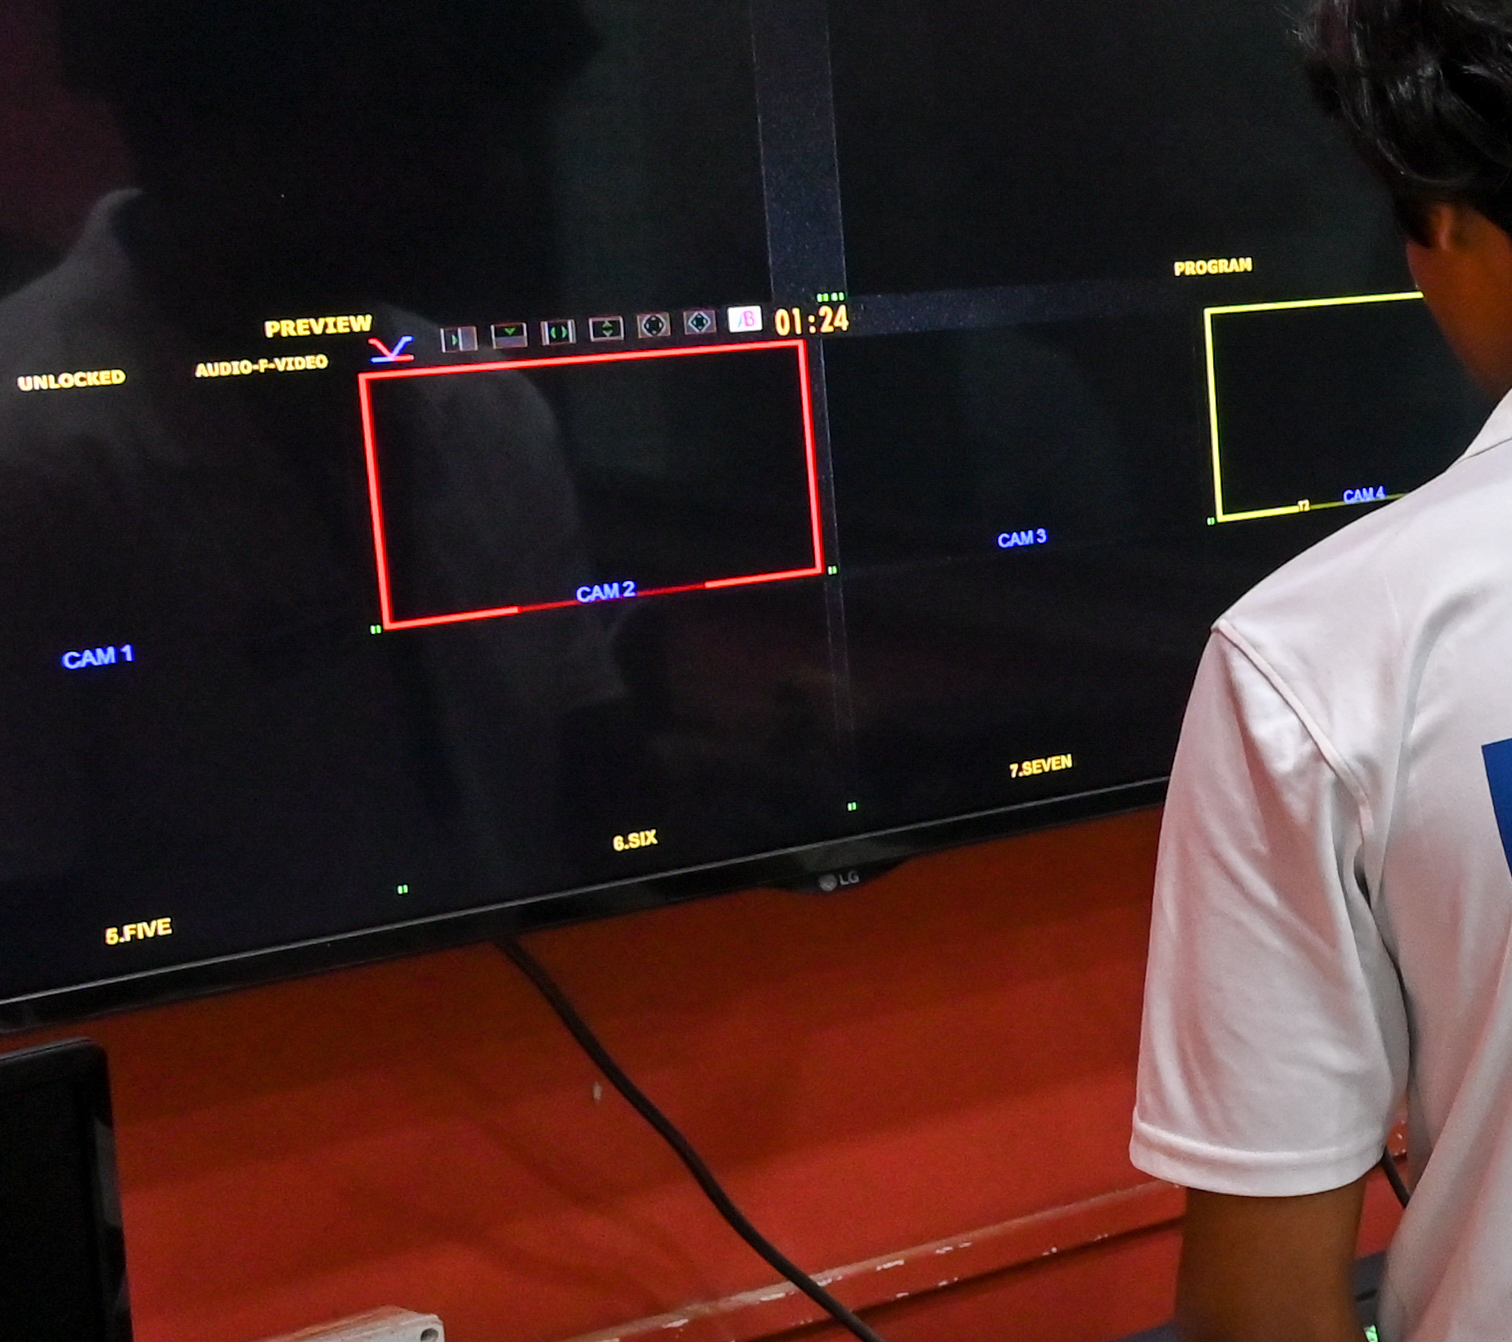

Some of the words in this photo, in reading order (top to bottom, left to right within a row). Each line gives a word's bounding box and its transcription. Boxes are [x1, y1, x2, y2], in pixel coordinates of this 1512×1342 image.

[1173, 256, 1254, 277] PROGRAM
[264, 314, 373, 338] PREVIEW
[774, 304, 850, 336] 01:24
[16, 369, 127, 392] UNLOCKED
[1343, 487, 1376, 505] CAM
[1376, 485, 1387, 500] 4
[997, 529, 1035, 549] CAM
[1036, 527, 1048, 544] 3
[576, 582, 620, 603] CAM
[622, 580, 637, 597] 2
[62, 645, 118, 670] CAM
[120, 643, 135, 662] 1
[1009, 753, 1073, 778] 7.SEVEN
[612, 828, 659, 852] 6.SIX
[839, 870, 860, 886] LG
